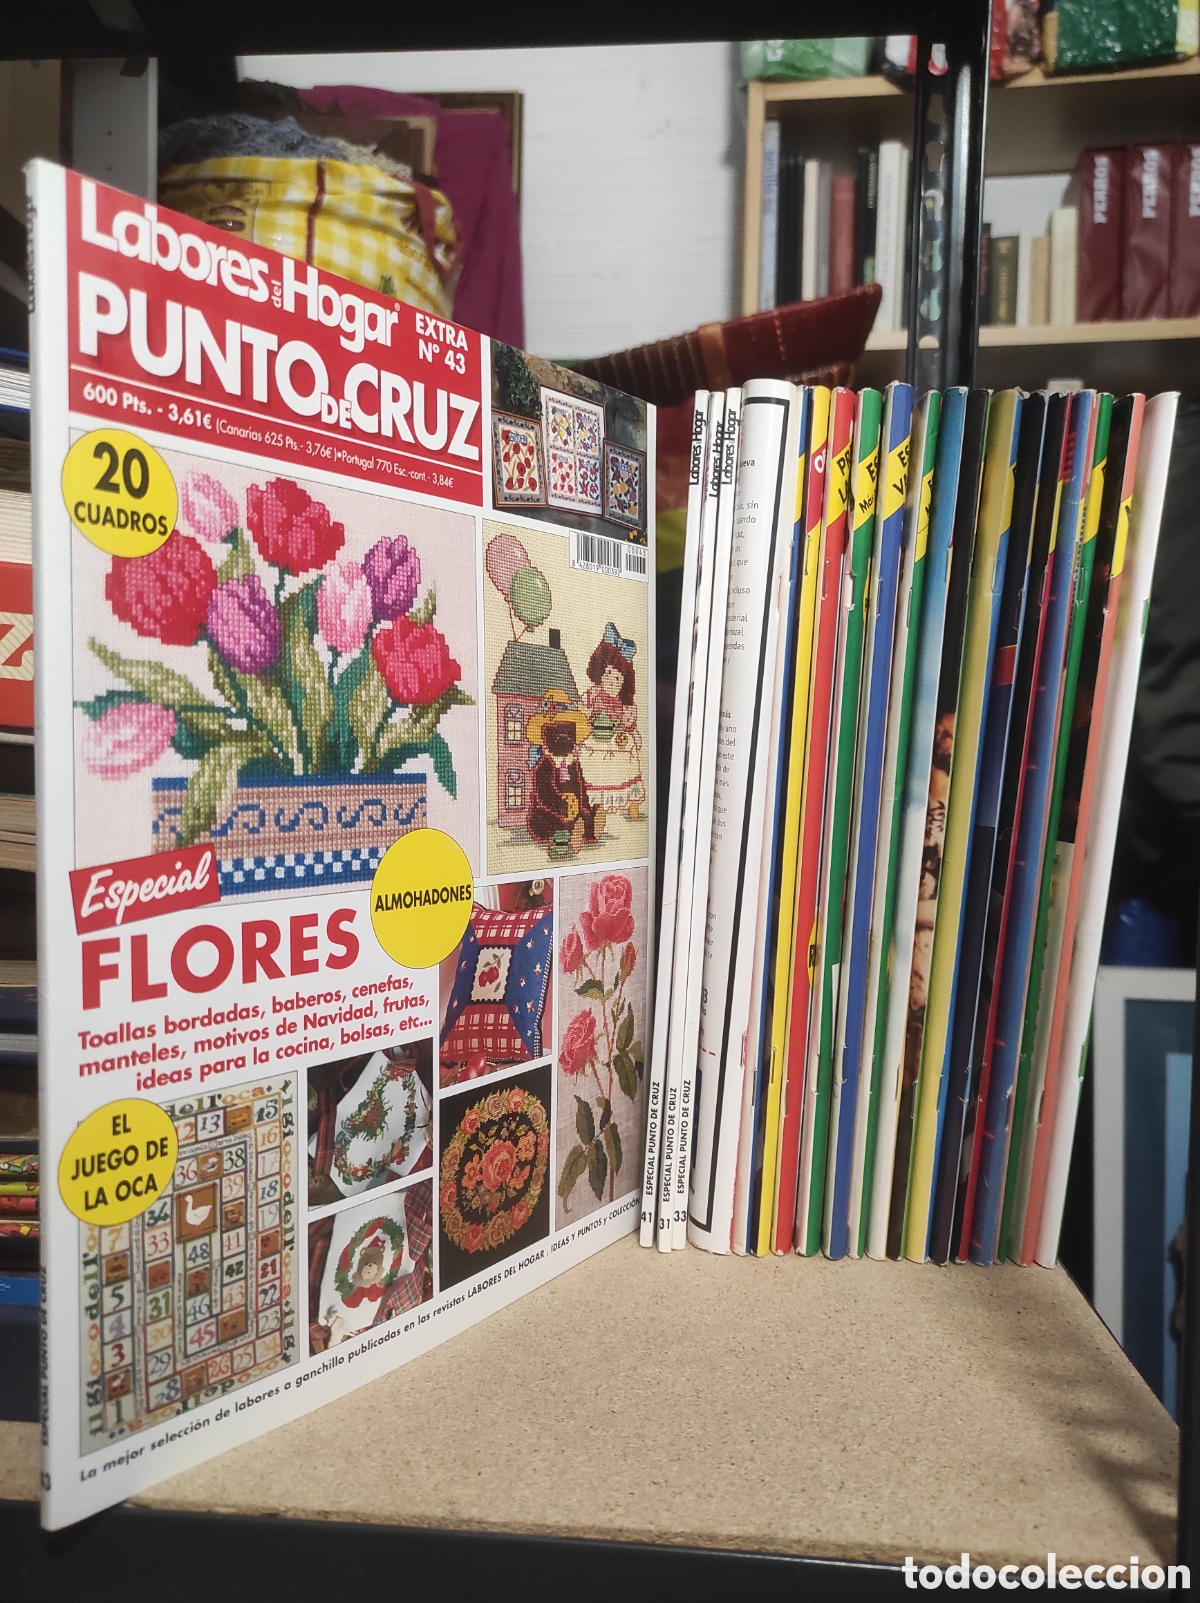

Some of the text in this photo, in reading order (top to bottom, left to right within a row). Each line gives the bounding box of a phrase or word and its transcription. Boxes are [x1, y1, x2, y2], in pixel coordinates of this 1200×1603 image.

[81, 179, 269, 303] Labores
[271, 280, 282, 308] del
[283, 257, 398, 353] Hogar
[415, 312, 468, 351] EXTRA
[78, 271, 480, 461] PUNTO DE CRUZ
[444, 350, 466, 375] 43
[83, 382, 118, 407] 600
[122, 392, 152, 416] Pts.
[168, 403, 212, 430] 3,61€
[216, 417, 262, 442] (Canarias
[265, 431, 283, 447] 625
[376, 458, 392, 474] 770
[432, 472, 454, 488] 3,84€
[689, 410, 707, 485] Labores Hogar
[721, 409, 740, 485] Labores Hogar
[93, 441, 150, 500] 20
[740, 459, 755, 468] ueva
[746, 500, 759, 509] sin
[74, 501, 169, 536] CUADROS
[80, 850, 212, 925] Especial
[375, 884, 472, 912] ALMOHADONES
[82, 908, 360, 1011] FLORES
[78, 974, 414, 1050] Toallas bordadas, baberos, cenefas,
[79, 993, 430, 1078] manteles, motivos de Navidad, frutas,
[136, 1015, 433, 1092] ideas para la cocina, bolsas, etc...
[201, 1113, 221, 1134] 13
[254, 1098, 278, 1123] 15
[111, 1113, 131, 1136] EL
[260, 1124, 279, 1147] 16
[677, 1079, 691, 1194] ESPECIAL PUNTO DE CRUZ
[646, 1082, 660, 1195] ESPECIAL PUNTO DE CRUZ
[663, 1087, 677, 1202] ESPECIAL PUNTO DE CRUZ
[71, 1144, 139, 1180] JUEGO
[146, 1136, 168, 1161] DE
[224, 1147, 246, 1172] 38
[175, 1158, 198, 1189] 36
[223, 1173, 244, 1199] 39
[84, 1173, 158, 1212] LA OCA
[260, 1180, 279, 1201] 18
[146, 1201, 169, 1228] 34
[641, 1211, 653, 1223] 41
[659, 1218, 671, 1230] 31
[674, 1210, 687, 1222] 33
[107, 1228, 123, 1252] 7
[148, 1231, 170, 1257] 33
[188, 1242, 210, 1264] 48
[225, 1258, 244, 1278] 42
[260, 1258, 278, 1279] 21
[110, 1284, 125, 1311] 5
[149, 1291, 170, 1320] 31
[109, 1313, 126, 1338] 4
[189, 1321, 216, 1348] 45
[259, 1310, 280, 1333] 23
[80, 1467, 98, 1482] La
[103, 1447, 145, 1473] mejor
[150, 1417, 210, 1451] selección
[214, 1408, 231, 1421] de
[235, 1385, 280, 1412] labores
[283, 1381, 292, 1390] a
[295, 1355, 345, 1387] ganchillo
[348, 1329, 401, 1363] publicadas
[404, 1321, 415, 1333] en
[418, 1312, 431, 1326] las
[433, 1294, 465, 1318] revistas
[467, 1273, 502, 1298] LABORES
[504, 1263, 517, 1278] DEL
[551, 1235, 570, 1253] IDEAS
[571, 1232, 576, 1242] Y
[577, 1217, 602, 1238] PUNTOS
[608, 1196, 640, 1220] COLECCIÓN
[111, 1342, 125, 1368] 3
[150, 1351, 172, 1377] 29
[154, 1378, 179, 1403] 28
